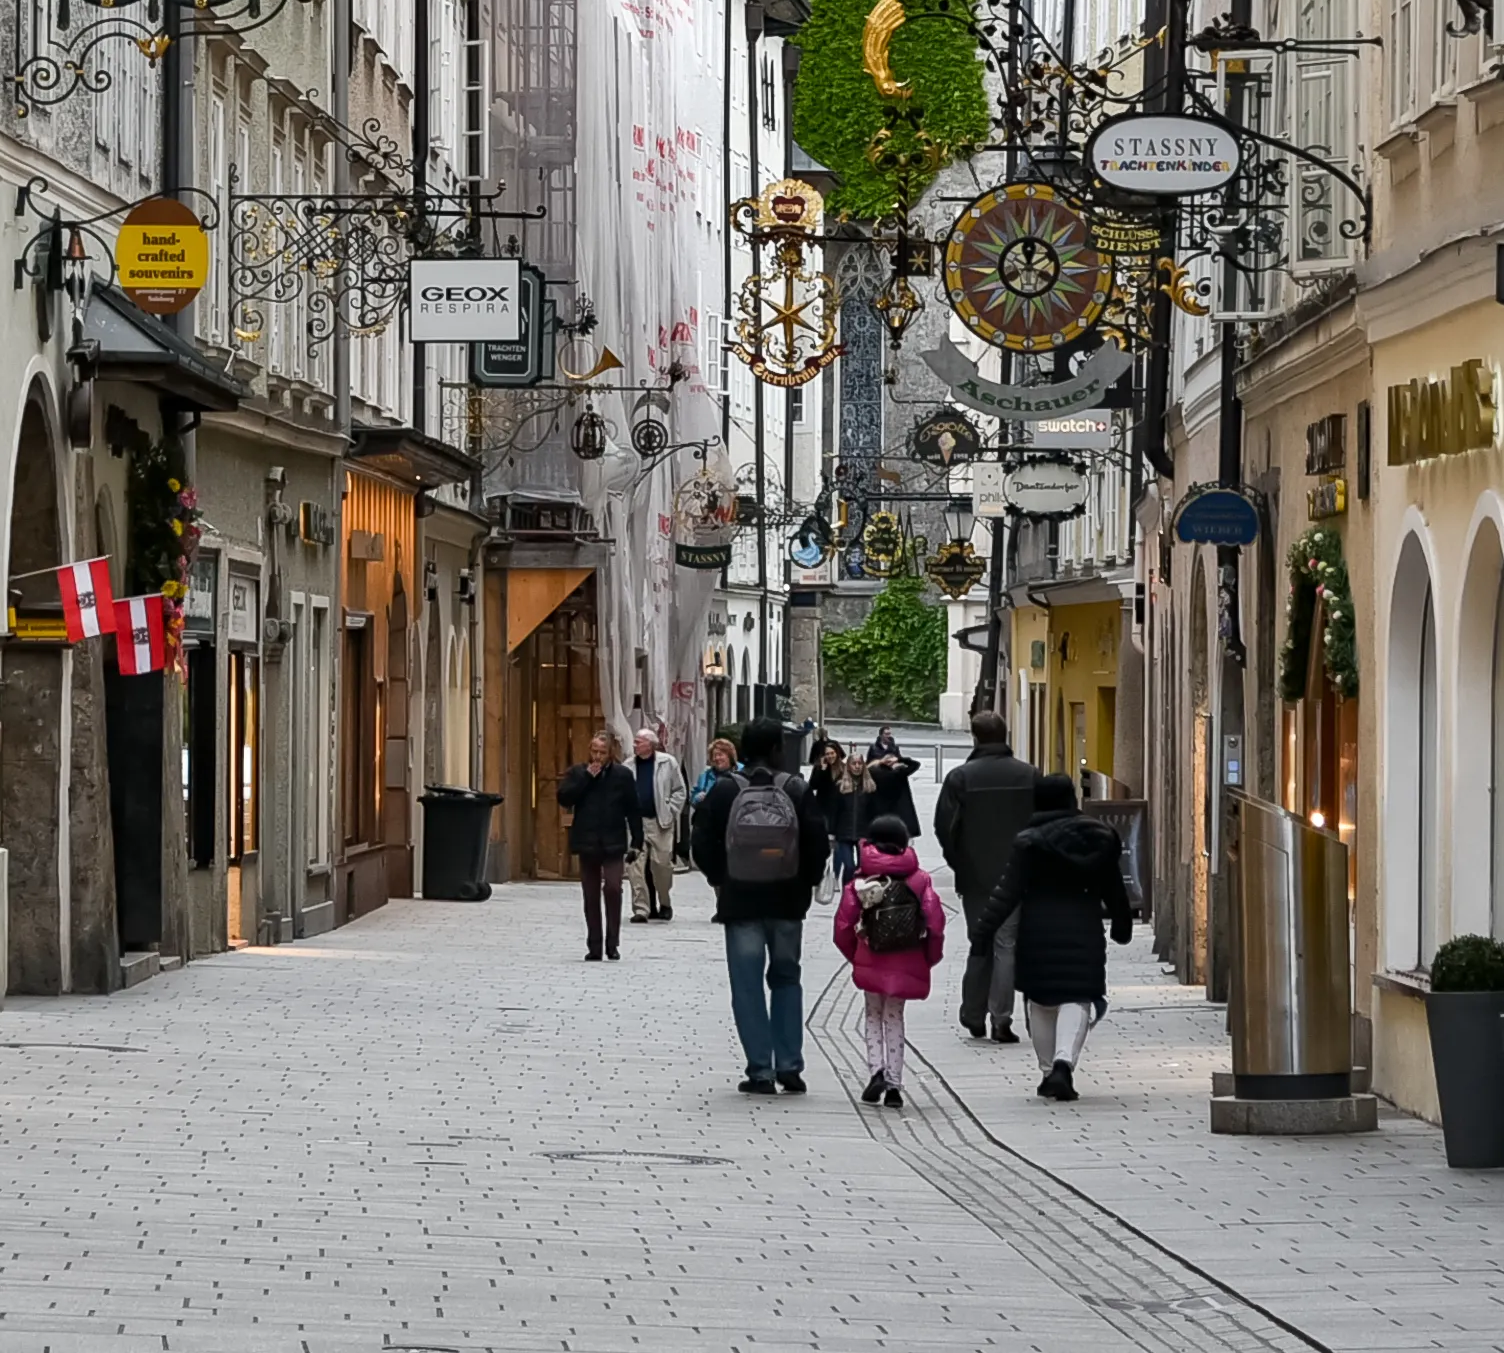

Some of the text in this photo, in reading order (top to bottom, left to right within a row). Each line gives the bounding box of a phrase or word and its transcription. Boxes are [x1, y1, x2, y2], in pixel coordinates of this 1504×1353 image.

[1113, 137, 1219, 156] STASSNY
[142, 232, 181, 246] hand-
[1095, 238, 1162, 252] DIENST
[137, 249, 186, 263] crafted
[128, 266, 194, 279] souvenirs
[420, 286, 510, 302] GEOX
[420, 303, 510, 314] RESPIRA
[488, 345, 526, 353] TRACHTEN
[490, 353, 522, 361] WENGER
[956, 378, 1101, 412] Aschauer
[1038, 419, 1096, 433] swatch
[679, 549, 729, 565] STASSNY
